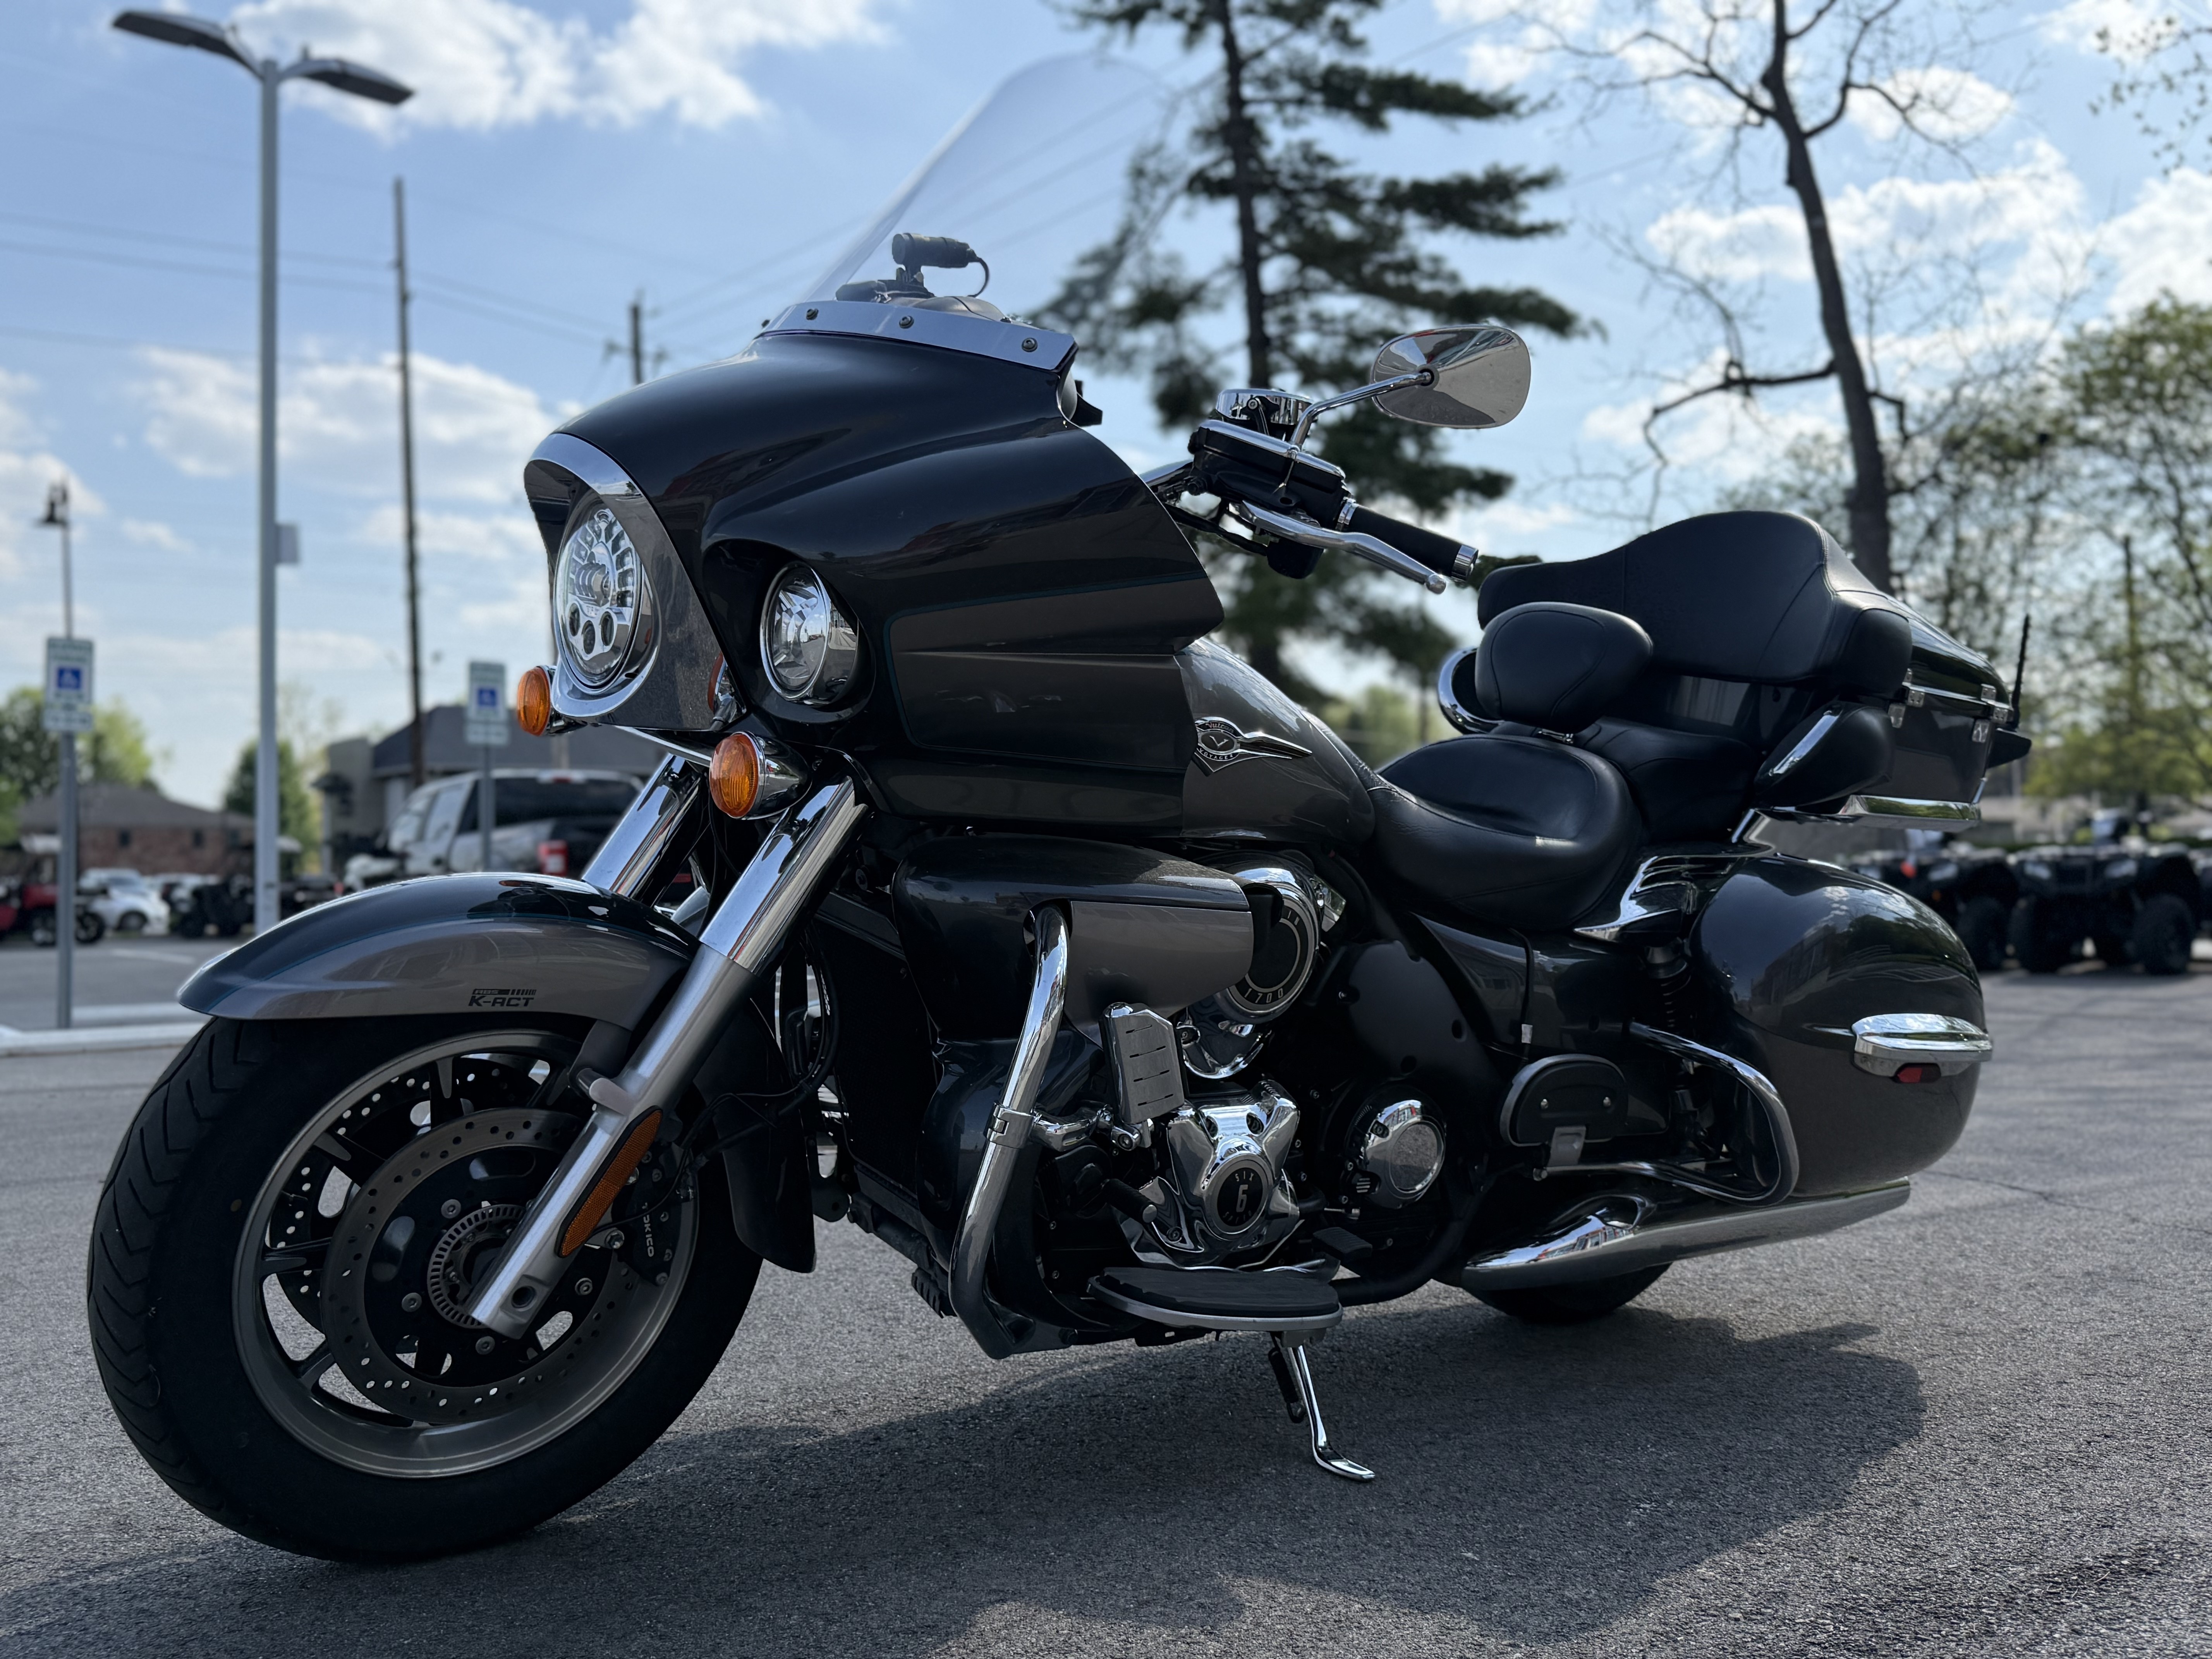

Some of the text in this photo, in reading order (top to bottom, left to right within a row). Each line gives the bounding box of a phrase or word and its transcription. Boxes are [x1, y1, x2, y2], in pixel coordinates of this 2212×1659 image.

[1205, 723, 1234, 733] Vulcan
[1199, 748, 1233, 760] VOYAGER
[1244, 988, 1283, 1003] 1700
[468, 996, 534, 1007] K-ACT
[1235, 1171, 1254, 1182] SIX
[1236, 1184, 1249, 1212] 6
